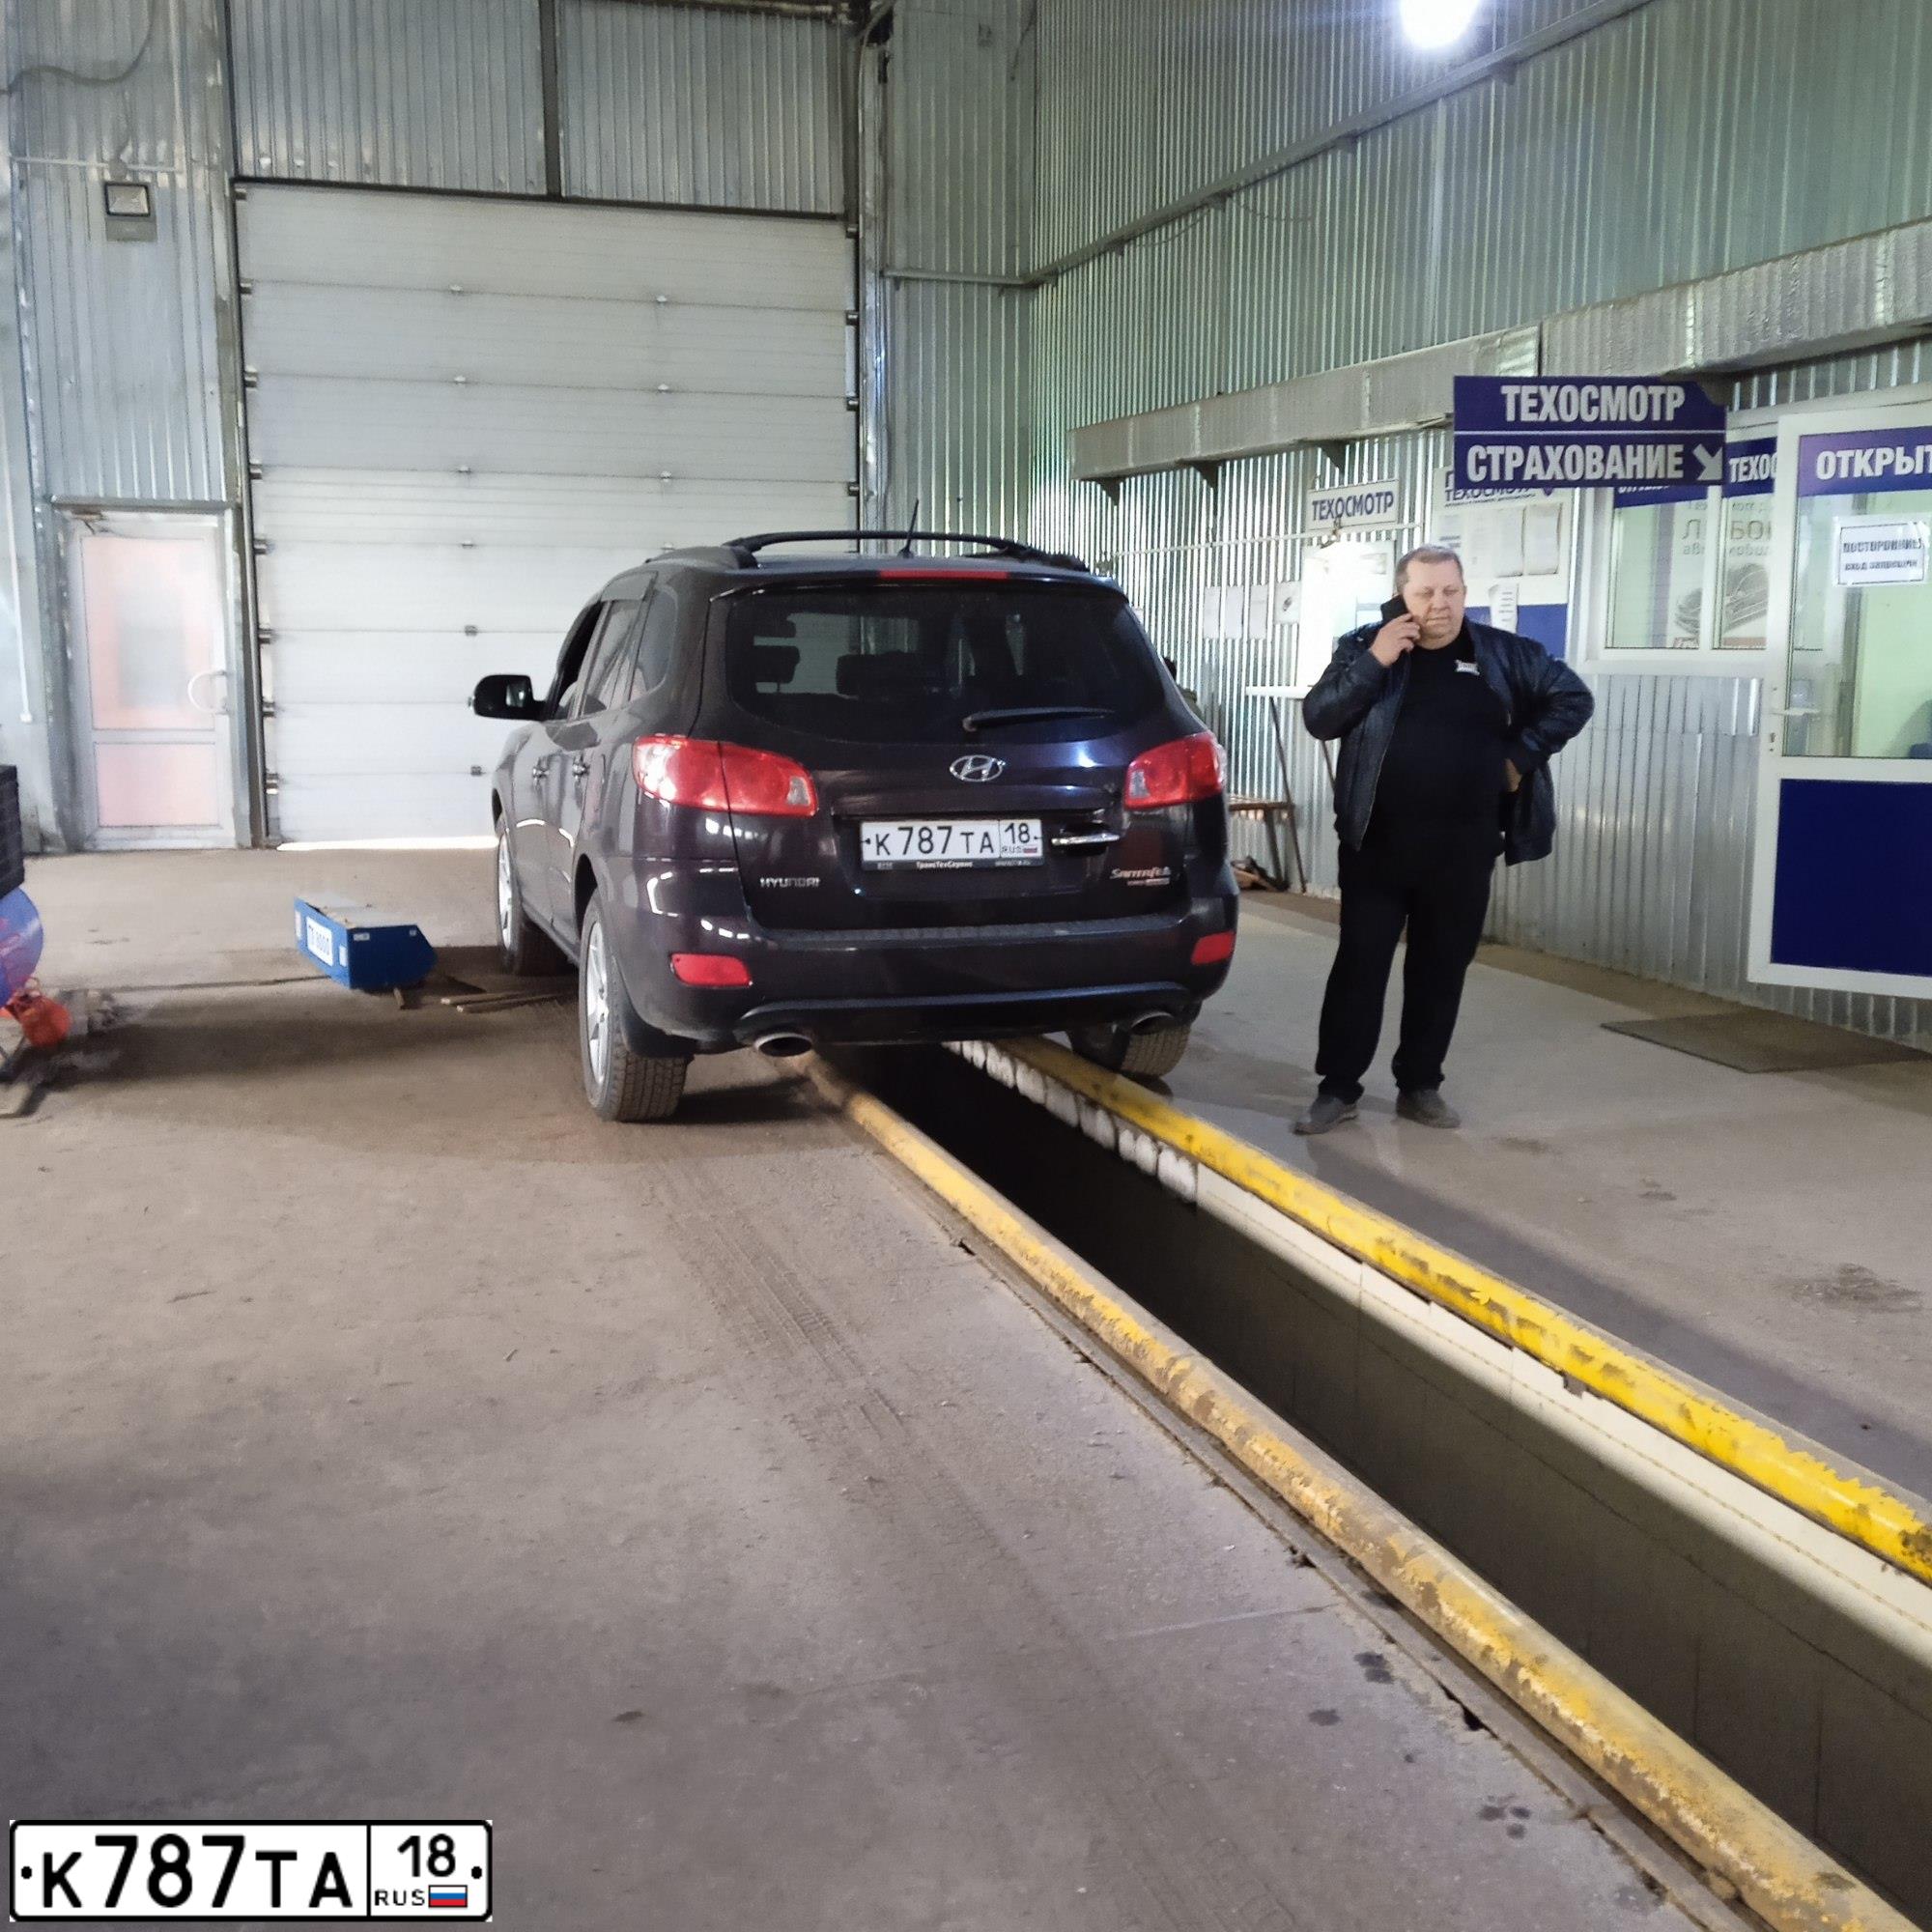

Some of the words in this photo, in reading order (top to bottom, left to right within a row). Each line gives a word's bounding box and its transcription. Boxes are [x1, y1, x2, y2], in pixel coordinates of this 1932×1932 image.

[1501, 384, 1686, 423] ТЕХОСМОТР
[1466, 443, 1685, 482] СТРАХОВАНИЕ
[1312, 491, 1394, 521] ТЕХОСМОТР
[1004, 822, 1031, 844] 18
